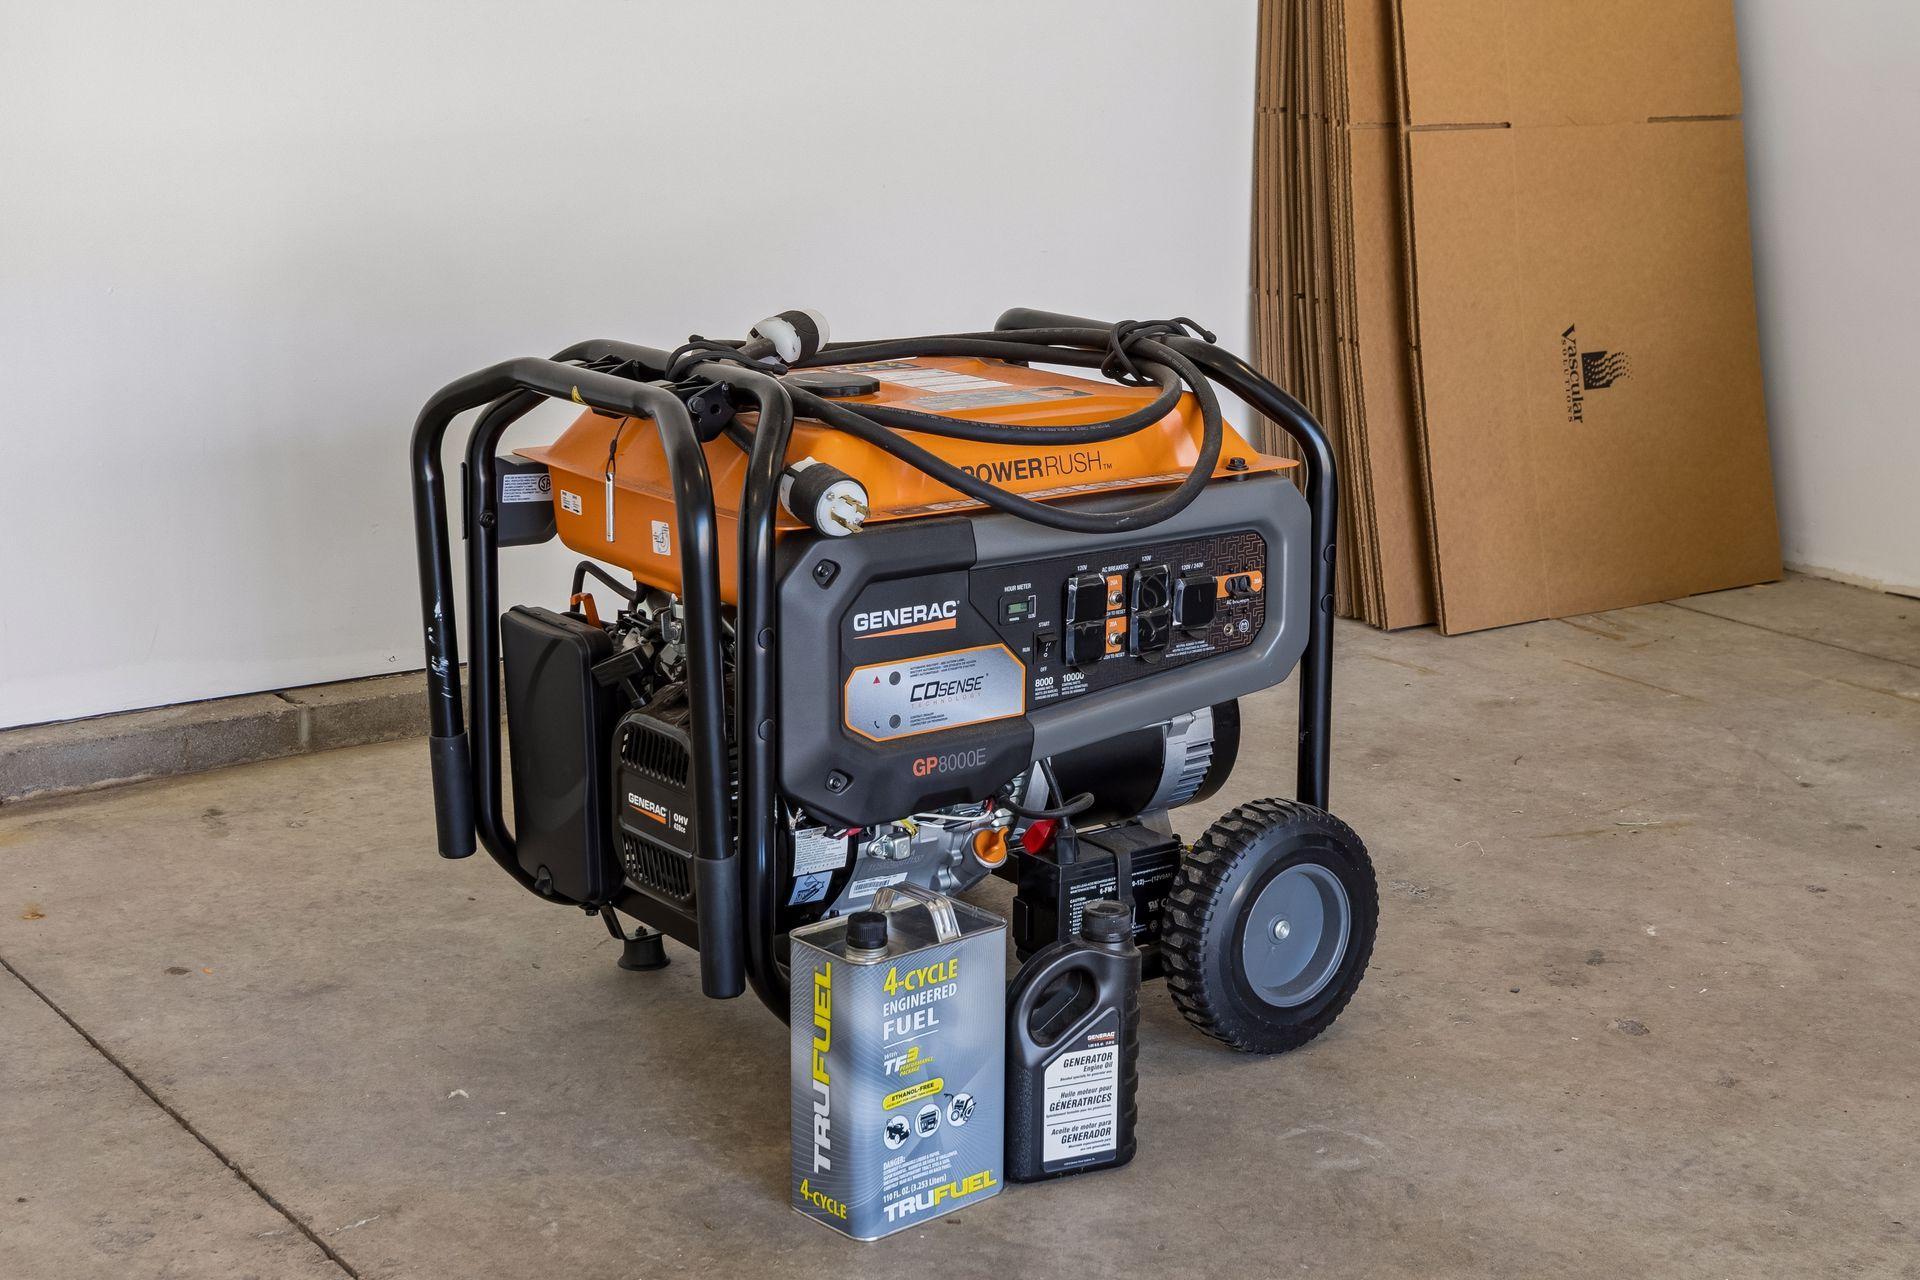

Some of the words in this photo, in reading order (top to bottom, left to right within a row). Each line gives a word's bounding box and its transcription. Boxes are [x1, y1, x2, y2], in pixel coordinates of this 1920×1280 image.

[1561, 322, 1584, 424] Vascular
[1561, 338, 1573, 423] SOLUTIONS
[853, 600, 957, 632] GENERAC
[1034, 676, 1054, 687] 8000
[1062, 672, 1085, 682] 10000
[912, 747, 986, 777] GP8000E
[628, 792, 667, 817] GENERAC
[673, 813, 688, 826] OHV
[883, 958, 958, 996] 4-CYCLE
[883, 983, 957, 1017] ENGINEERED
[883, 1007, 940, 1041] FUEL
[812, 961, 832, 1174] TRUFUEL
[1063, 1052, 1113, 1068] GENERATOR
[1083, 1063, 1103, 1072] Engine
[892, 1082, 935, 1101] ETHANOL-FREE
[1049, 1092, 1112, 1112] GÉNÉRATRICES
[1061, 1091, 1076, 1099] Huile
[1077, 1087, 1098, 1096] moteur
[1099, 1085, 1112, 1093] pour
[1051, 1127, 1070, 1136] Aceite
[1080, 1122, 1097, 1131] motor
[1098, 1120, 1111, 1128] para
[1061, 1127, 1112, 1144] GENERADOR
[800, 1178, 847, 1220] 4-CYCLE
[883, 1170, 998, 1223] TRUFUEL
